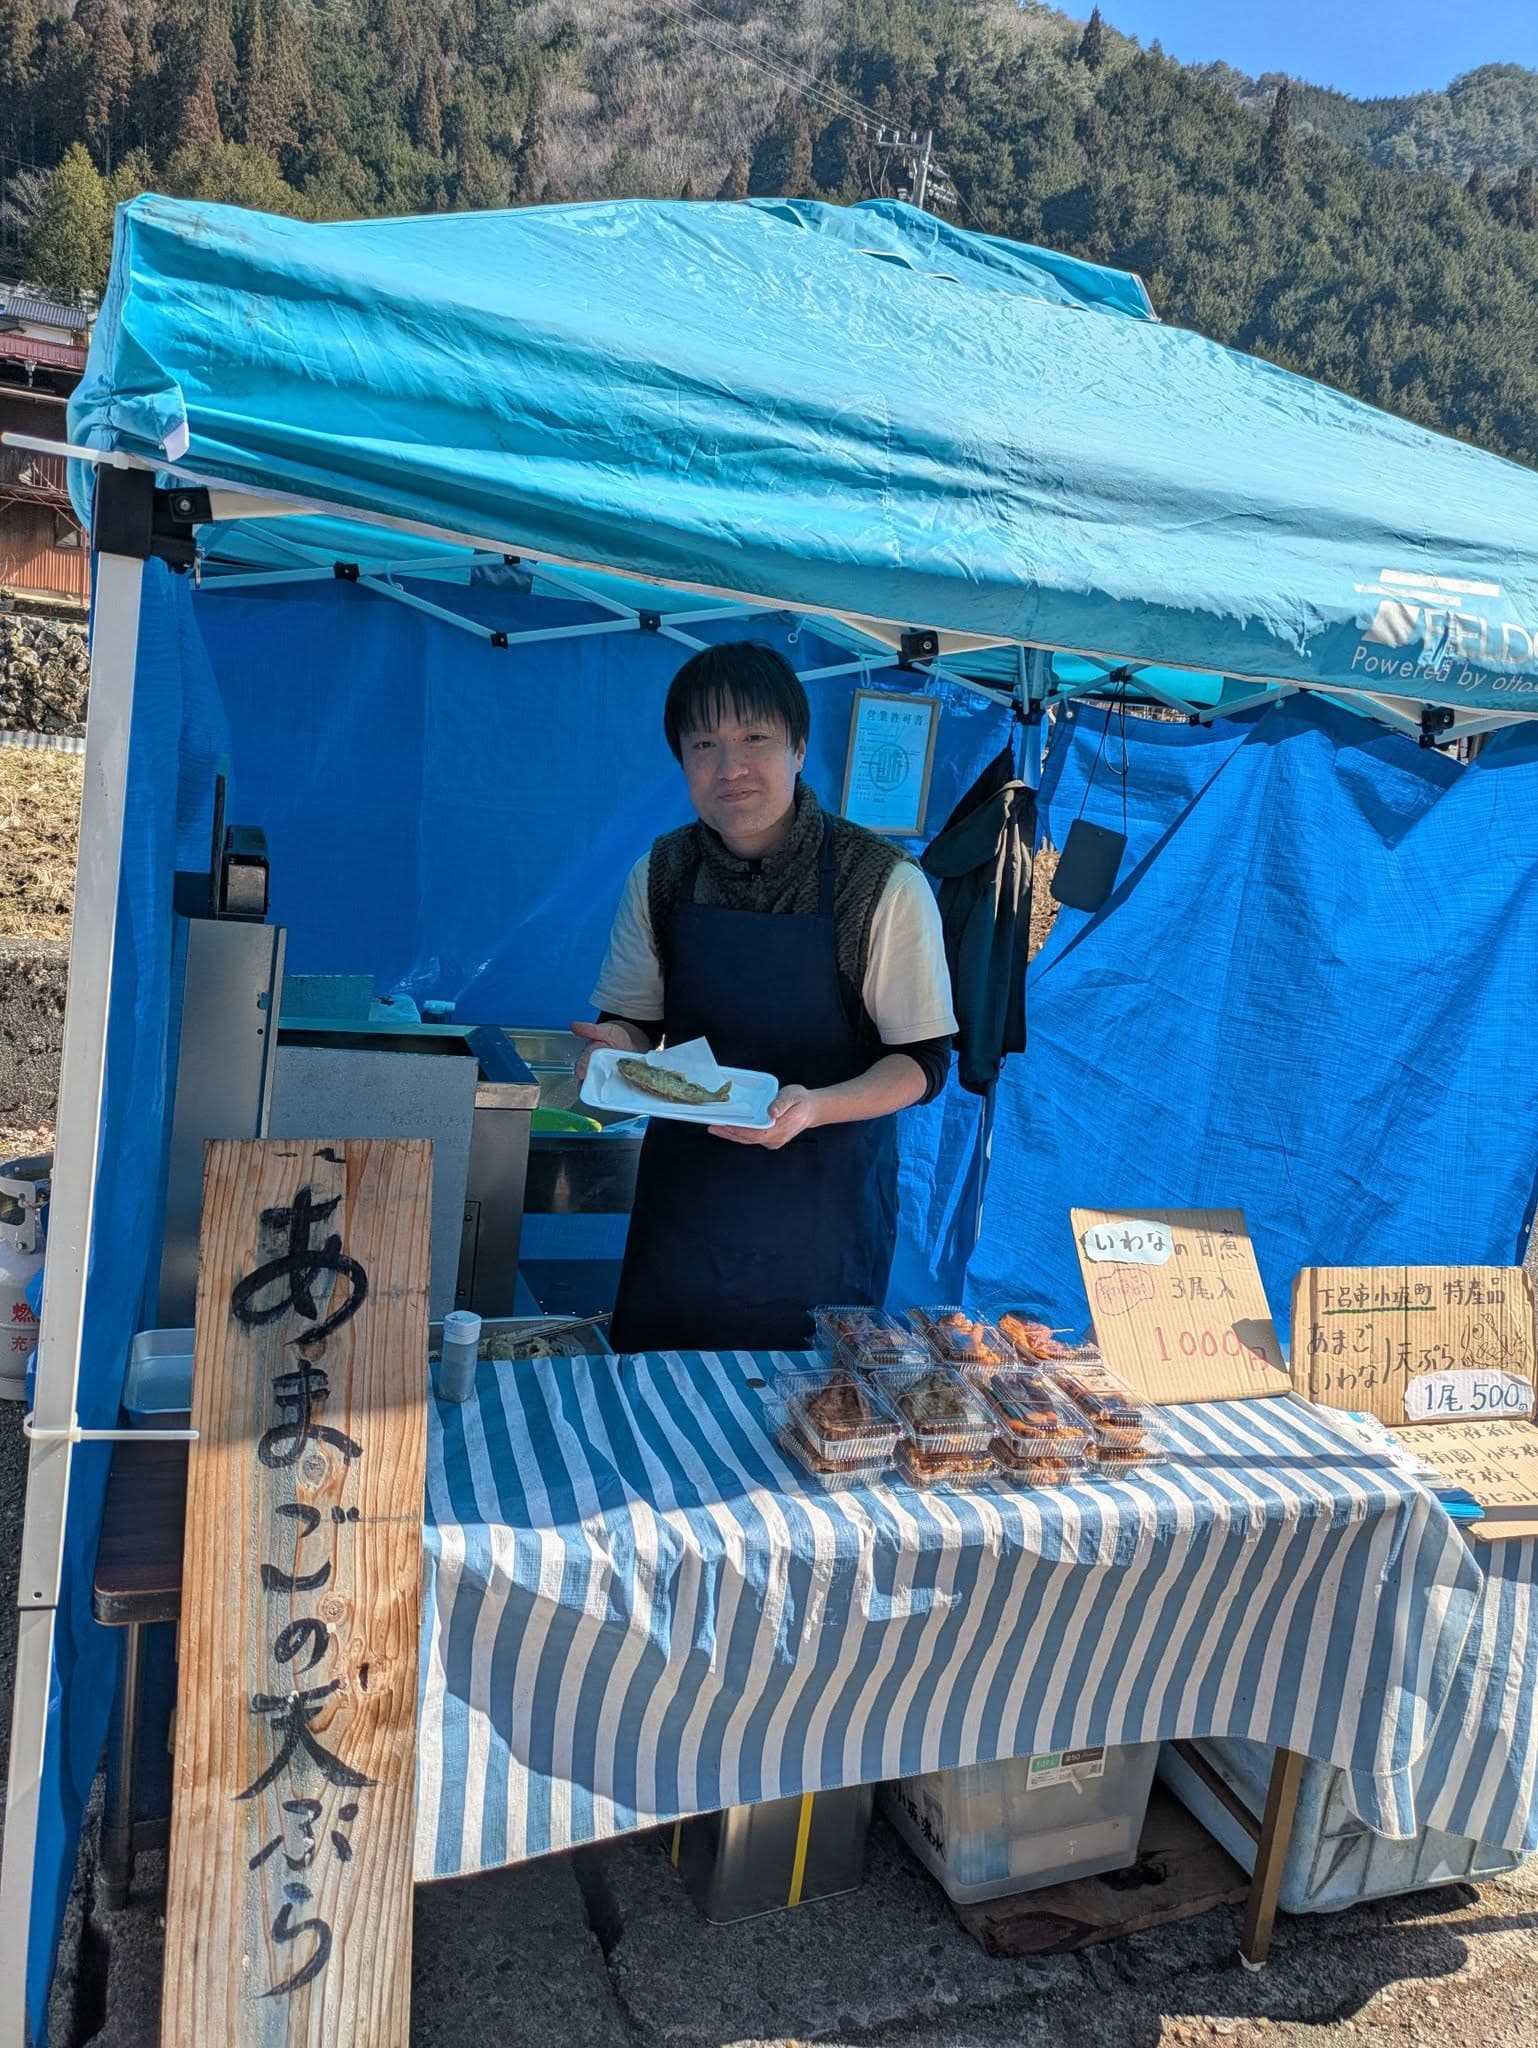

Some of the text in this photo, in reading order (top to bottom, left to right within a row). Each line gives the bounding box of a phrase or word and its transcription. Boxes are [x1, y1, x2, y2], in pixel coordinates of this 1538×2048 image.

[1423, 608, 1538, 664] FIELD
[1352, 646, 1450, 682] Powered
[1458, 661, 1487, 691] by
[1169, 1276, 1236, 1300] 3尾入
[1443, 1276, 1506, 1307] 特産品
[1155, 1326, 1269, 1372] 1000円
[1307, 1322, 1374, 1356] あまご
[1393, 1342, 1456, 1373] 天ぷら
[1308, 1364, 1379, 1395] いわな
[231, 1187, 382, 1998] あまごの天ぷら
